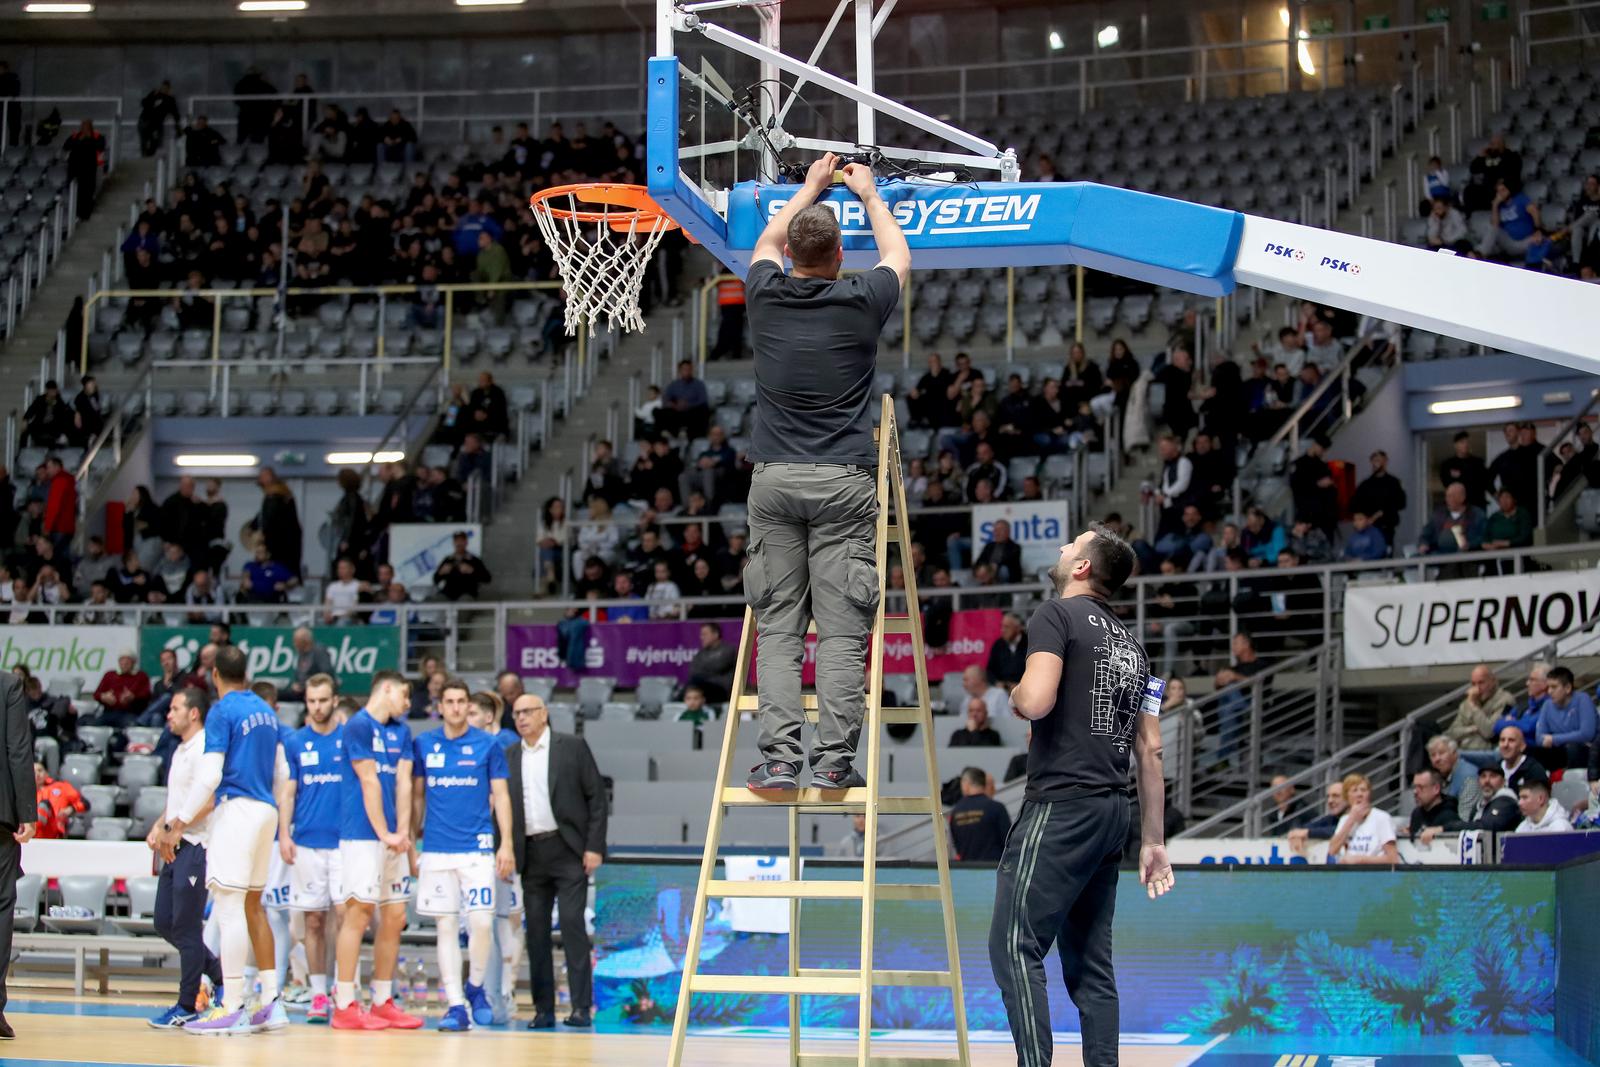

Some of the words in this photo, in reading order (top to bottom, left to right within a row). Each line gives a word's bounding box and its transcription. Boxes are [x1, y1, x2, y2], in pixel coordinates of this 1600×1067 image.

[1264, 243, 1294, 258] PSK
[1320, 256, 1350, 272] PSK
[980, 514, 1060, 544] snta
[1088, 614, 1134, 642] CRUY
[1371, 590, 1600, 648] SUPERNOV
[521, 647, 567, 669] ERS
[469, 887, 492, 906] 20
